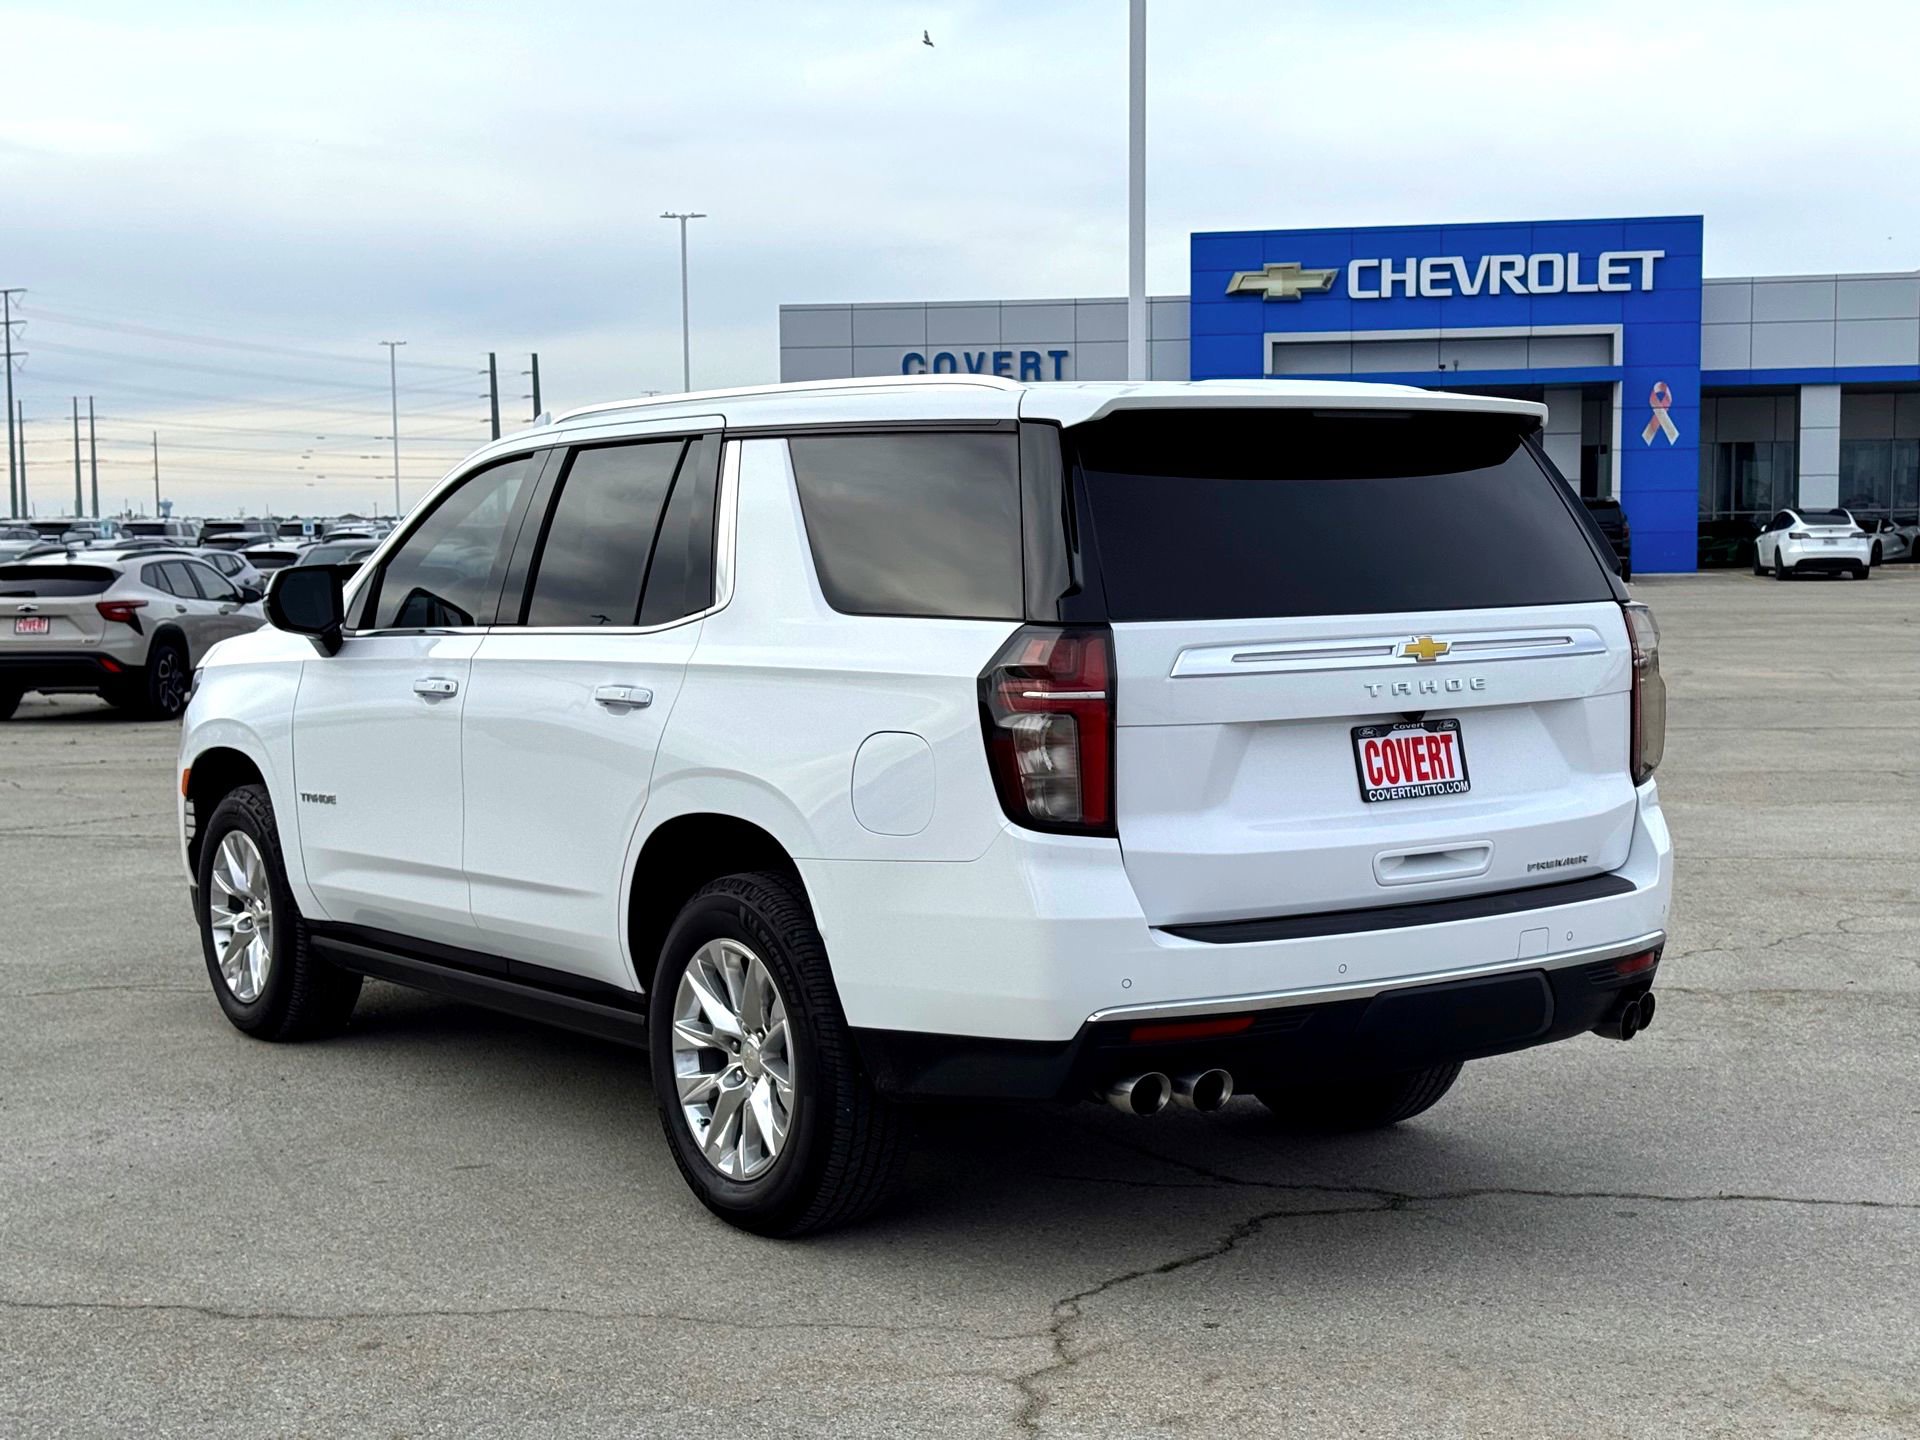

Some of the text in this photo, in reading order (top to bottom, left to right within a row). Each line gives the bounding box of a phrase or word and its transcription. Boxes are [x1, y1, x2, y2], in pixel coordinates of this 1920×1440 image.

[1348, 250, 1665, 299] CHEVROLET
[902, 350, 1069, 381] COVERT
[1364, 678, 1486, 697] TAHOE
[1393, 722, 1425, 730] Covert
[1364, 734, 1456, 787] COVERT
[300, 792, 337, 804] TAHOE
[1369, 781, 1469, 801] COVERTHUTTO.COM
[1527, 855, 1588, 872] PREMIER
